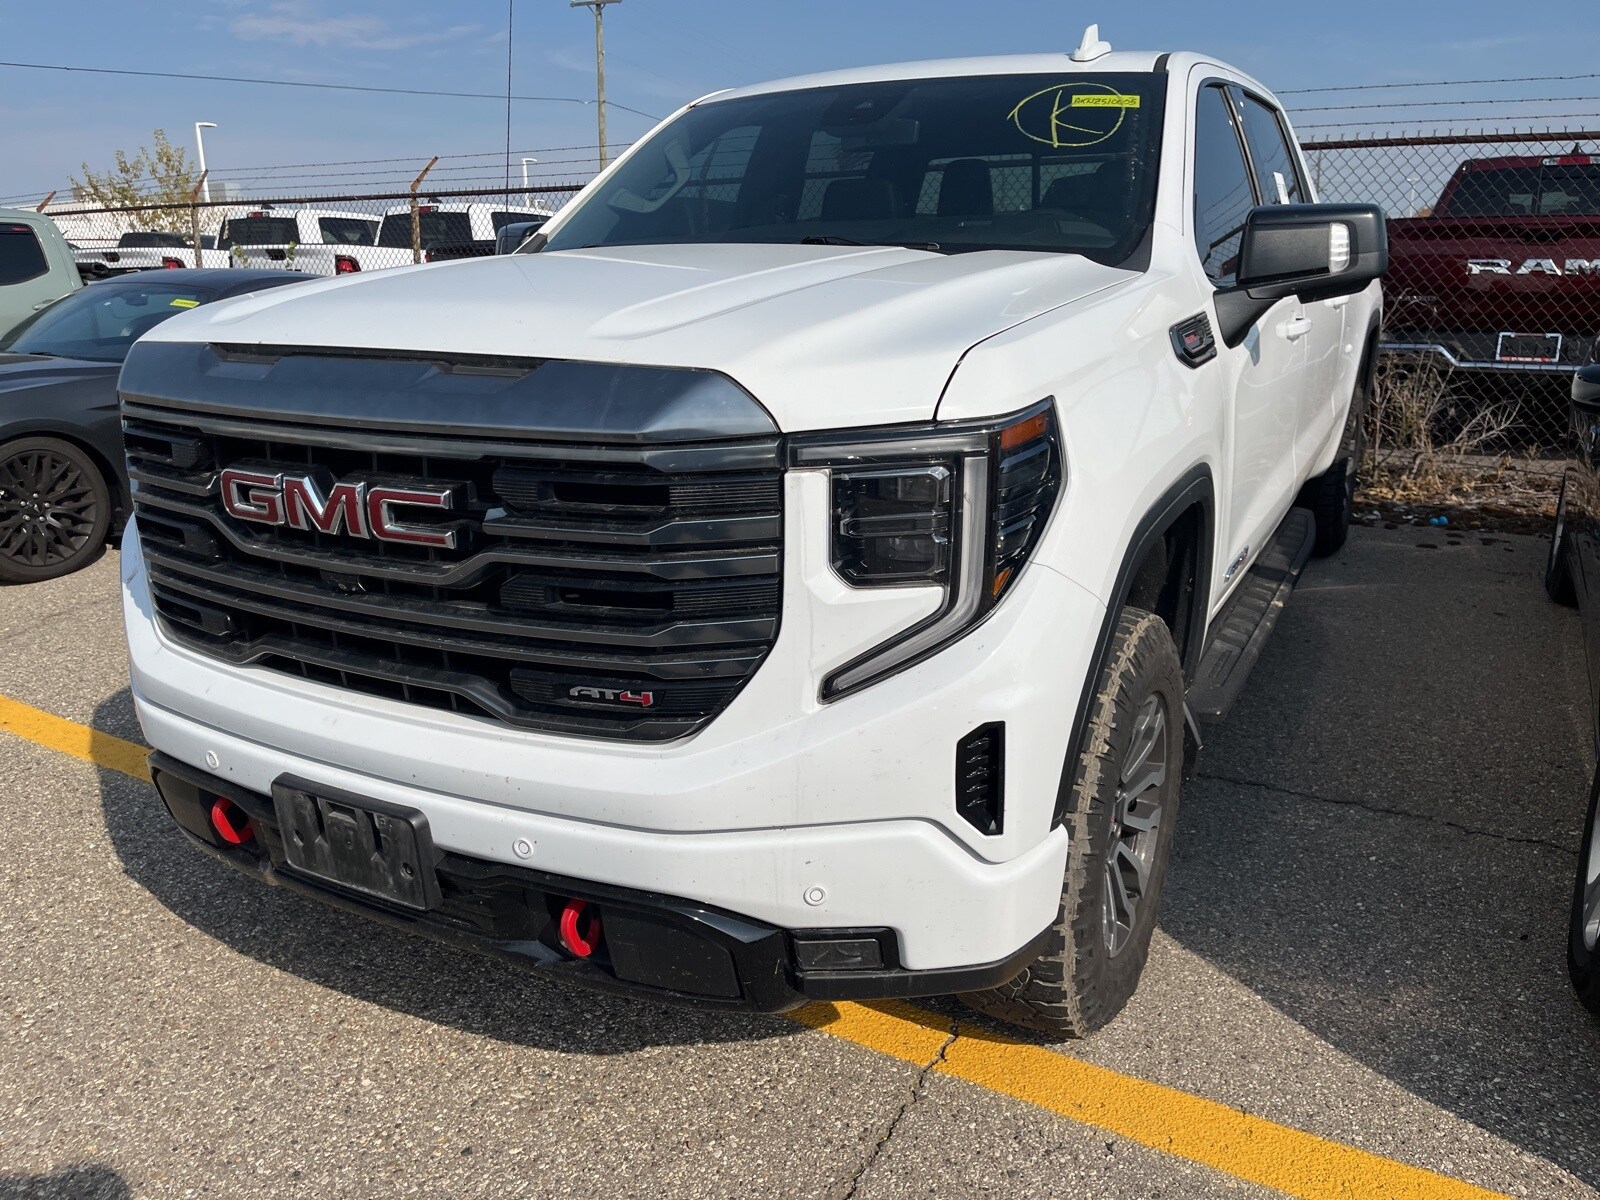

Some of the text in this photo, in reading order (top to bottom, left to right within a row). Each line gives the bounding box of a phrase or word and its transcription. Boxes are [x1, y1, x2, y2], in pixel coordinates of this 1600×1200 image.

[1466, 258, 1600, 276] RAM
[220, 468, 457, 549] GMC
[569, 685, 654, 707] AT4
